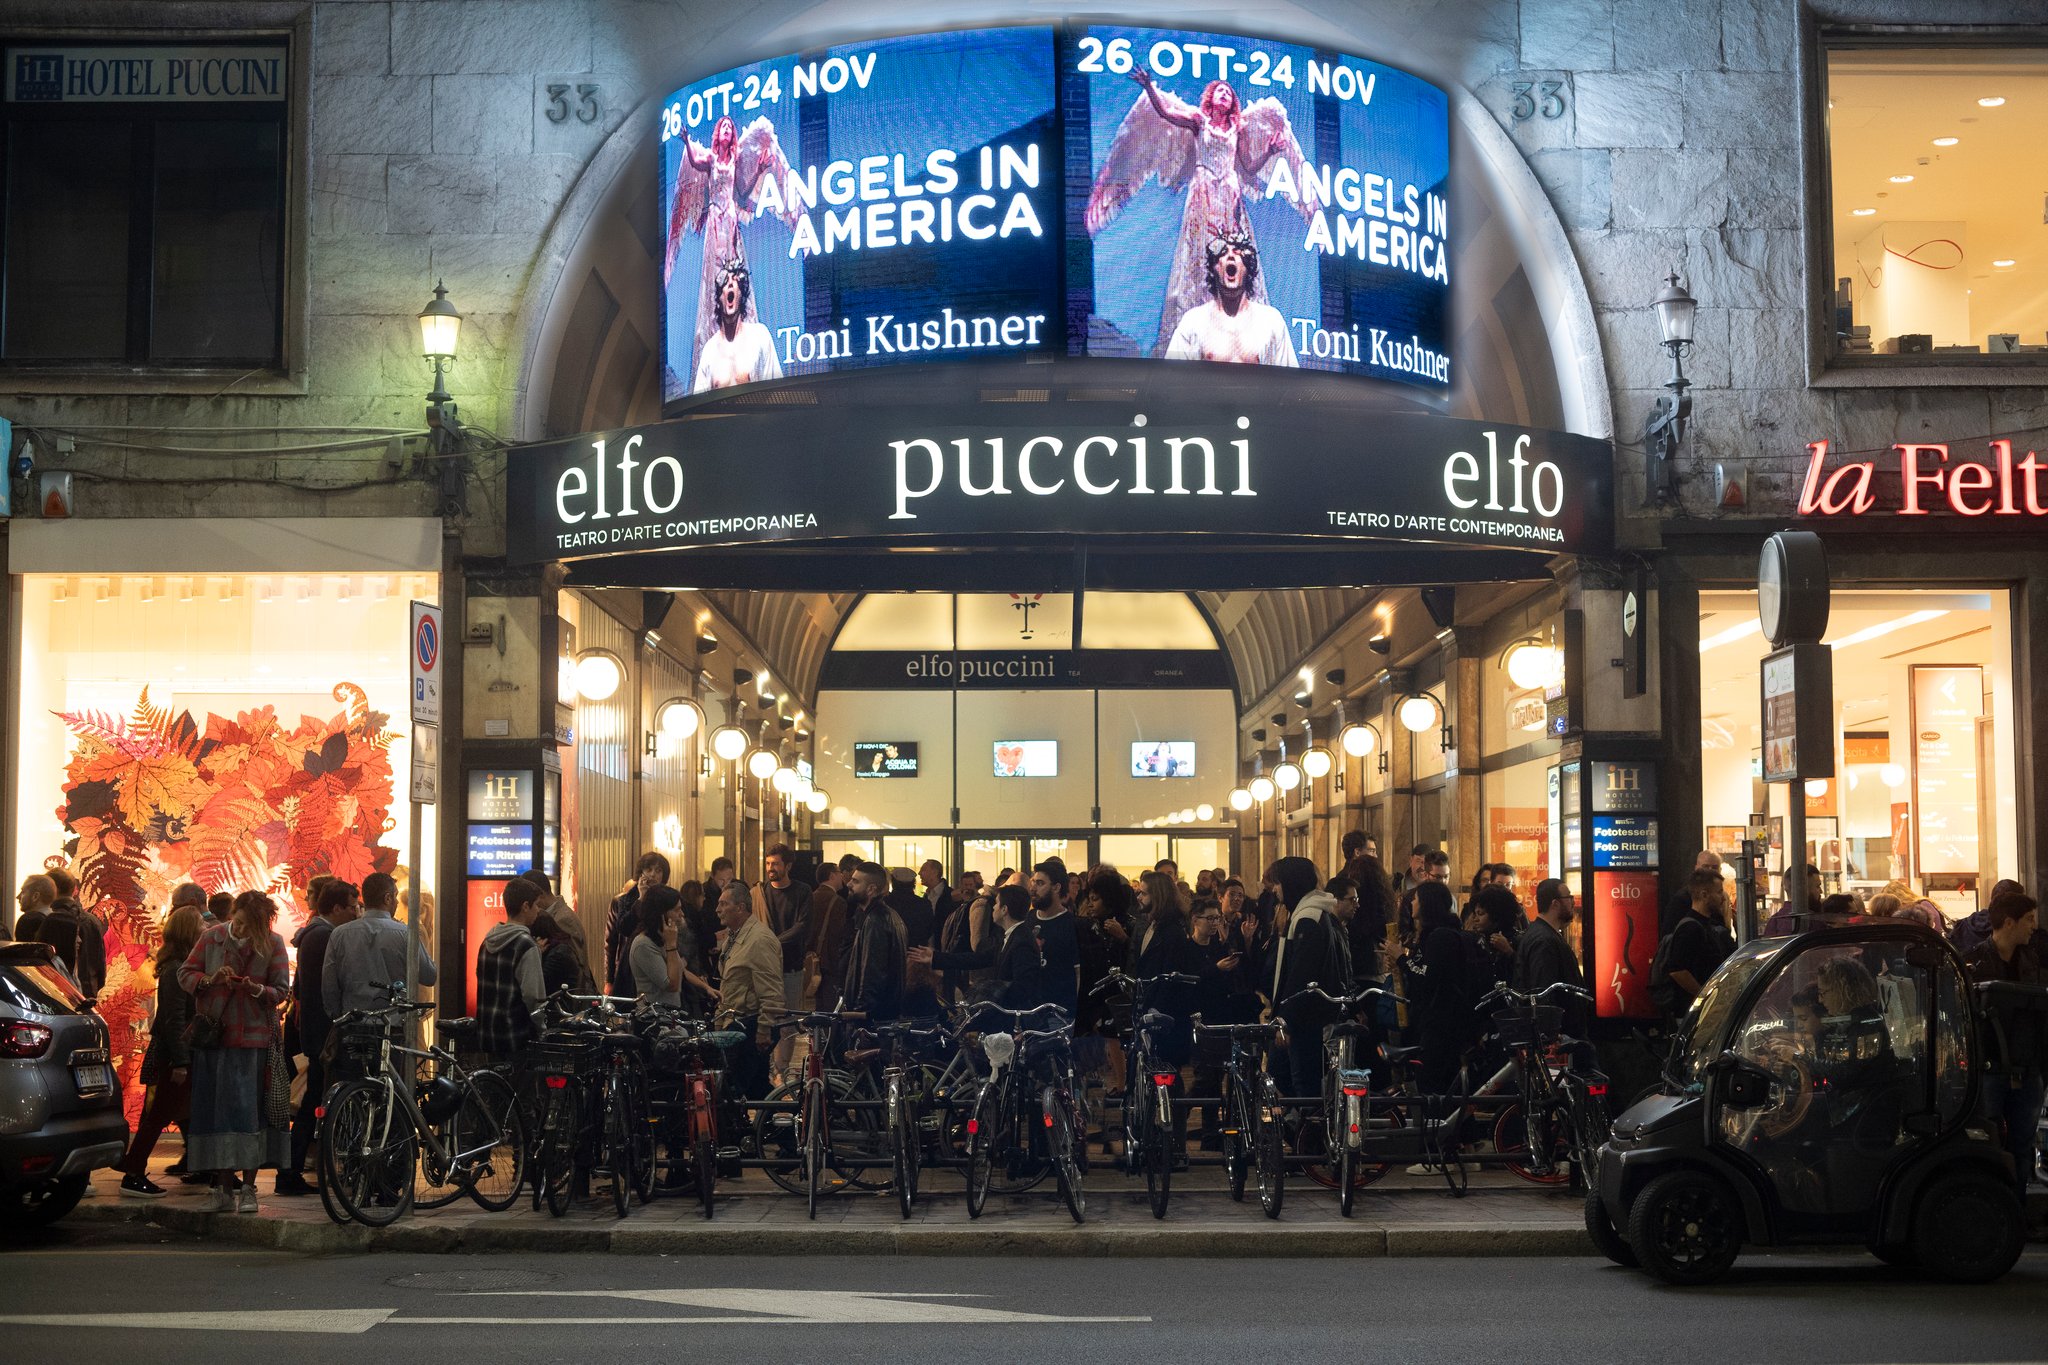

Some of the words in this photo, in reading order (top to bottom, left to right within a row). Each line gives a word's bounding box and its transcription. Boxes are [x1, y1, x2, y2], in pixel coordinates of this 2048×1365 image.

[66, 59, 161, 96] HOTEL
[167, 58, 280, 96] PUCCINI
[1077, 37, 1134, 74] 26
[1149, 40, 1295, 90] OTT-24
[1307, 59, 1376, 105] NOV
[546, 83, 601, 123] 33
[661, 101, 682, 142] 26
[686, 70, 782, 128] OTT-24
[793, 52, 877, 99] NOV
[1511, 81, 1565, 120] 33
[755, 148, 959, 219] ANGELS
[980, 143, 1040, 191] IN
[1265, 157, 1420, 227] ANGELS
[1426, 195, 1447, 241] IN
[788, 192, 1043, 260] AMERICA
[1303, 209, 1449, 286] AMERICA
[777, 318, 853, 365] Toni
[866, 308, 1046, 355] Kushner
[1291, 317, 1361, 363] Toni
[1369, 327, 1450, 384] Kushner
[556, 434, 684, 524] elfo
[888, 413, 1258, 520] puccini
[1443, 431, 1564, 518] elfo
[1797, 439, 1876, 516] la
[1891, 439, 2048, 516] Felt
[556, 530, 608, 549] TEATRO
[611, 524, 662, 543] D'ARTE
[665, 513, 818, 538] CONTEMPORANEA
[1326, 511, 1390, 528] TEATRO
[1394, 514, 1447, 531] D'ARTE
[1449, 518, 1565, 543] CONTEMPORANEA
[906, 654, 953, 677] elfo
[959, 655, 1056, 683] puccini
[470, 836, 532, 846] Fototessera
[470, 850, 495, 860] Foto
[496, 850, 532, 860] Ritratti
[1594, 827, 1656, 837] Fototessera
[1594, 842, 1619, 851] Foto
[1621, 842, 1656, 851] Ritratti
[484, 892, 504, 908] elf
[1611, 883, 1641, 899] elfo
